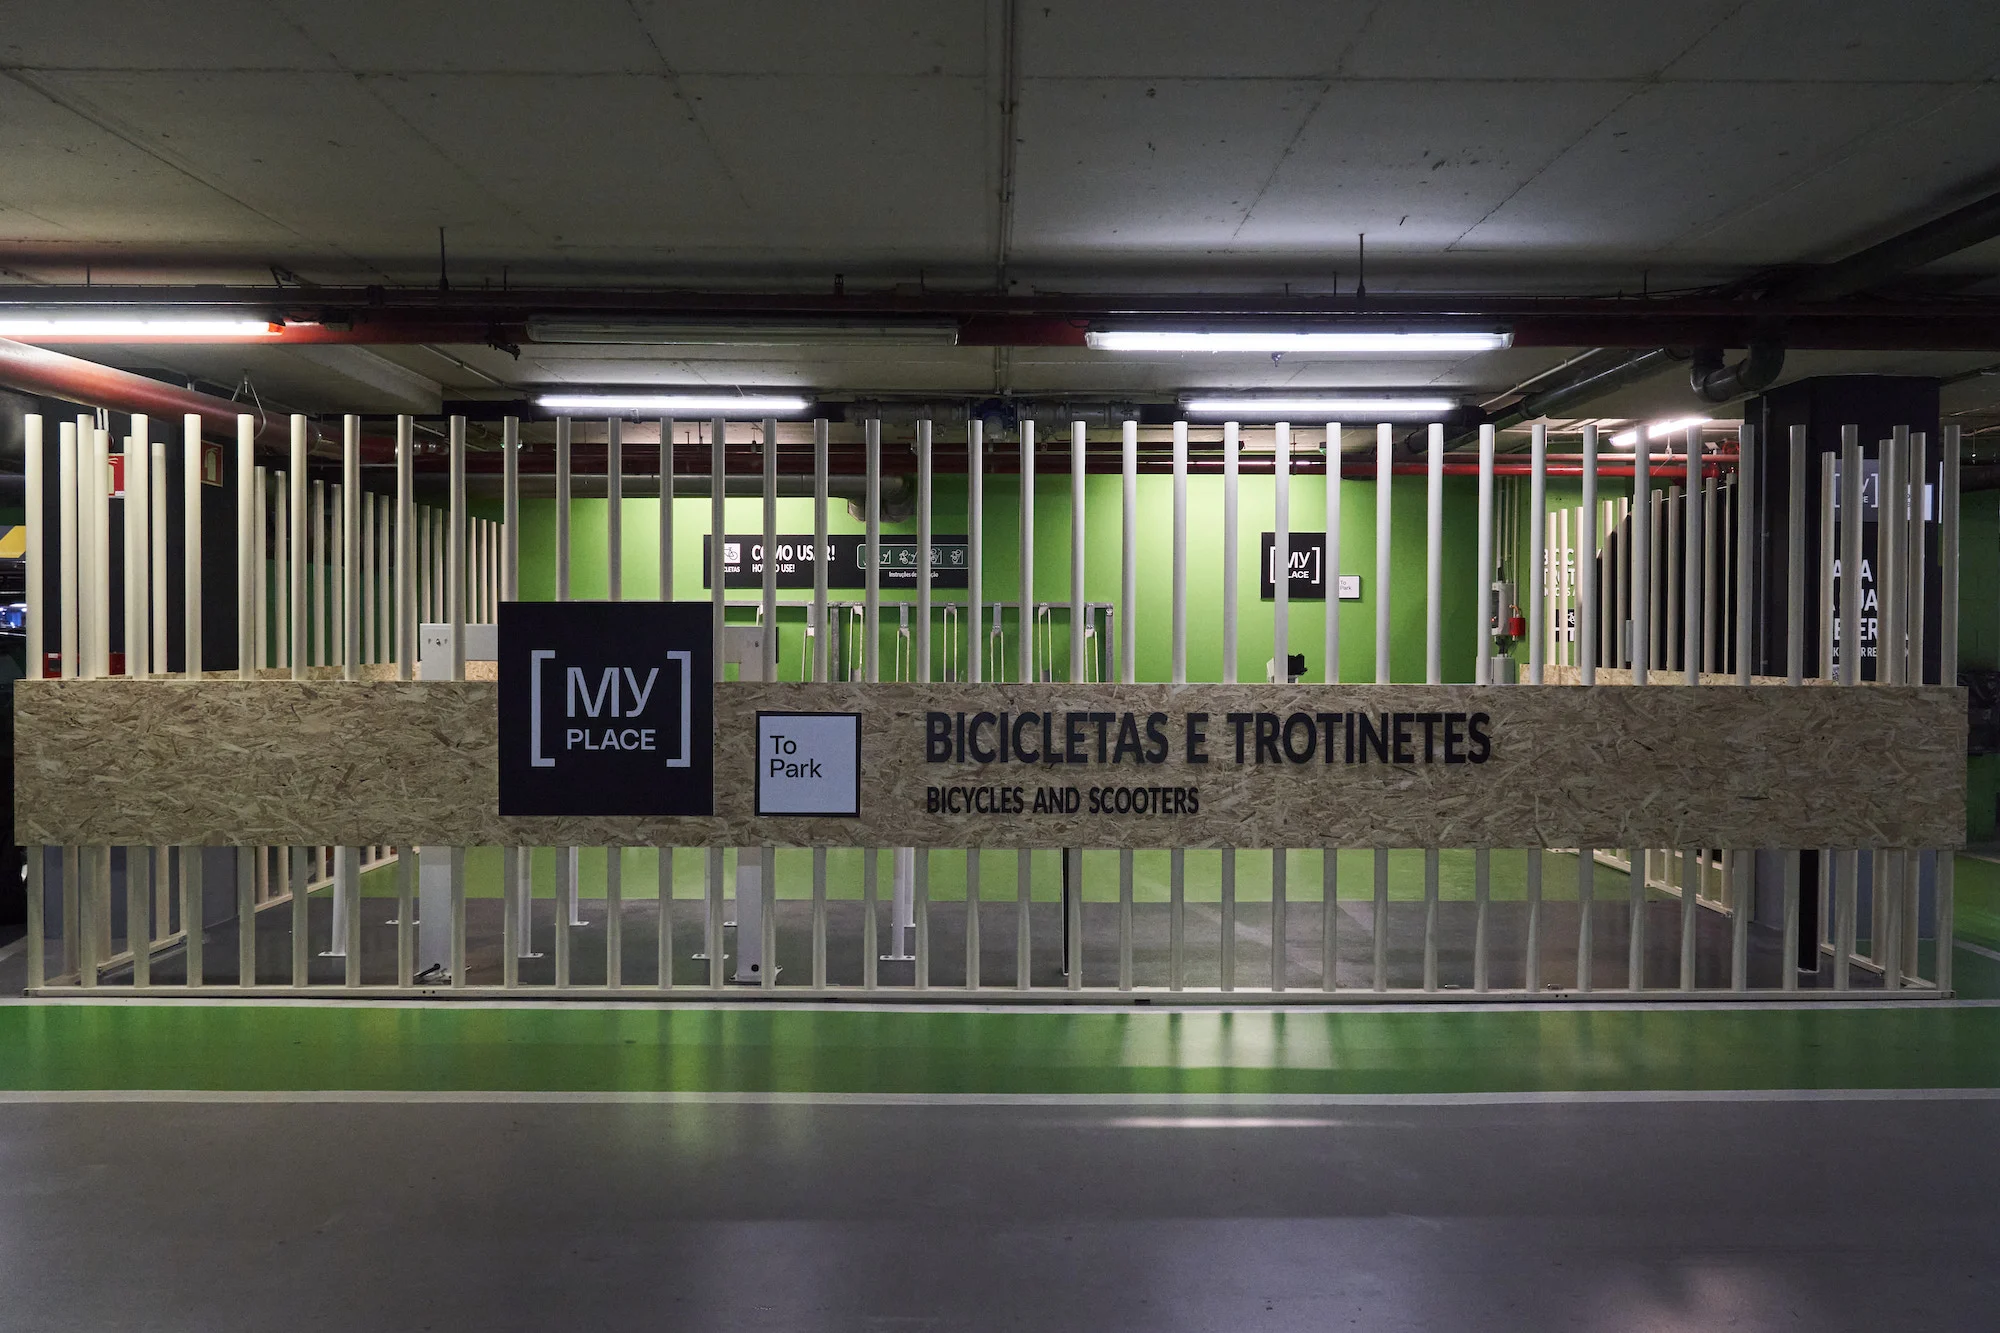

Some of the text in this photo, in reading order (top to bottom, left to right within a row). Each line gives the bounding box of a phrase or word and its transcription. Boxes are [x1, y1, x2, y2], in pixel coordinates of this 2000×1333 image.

[796, 545, 835, 561] USR!
[781, 564, 796, 572] USE!
[566, 728, 656, 751] PLACE
[770, 735, 797, 755] To
[926, 711, 1491, 765] BICICLETAS E TROTINETES
[770, 759, 822, 778] Park
[926, 787, 1199, 814] BICYCLES AND SCOOTERS
